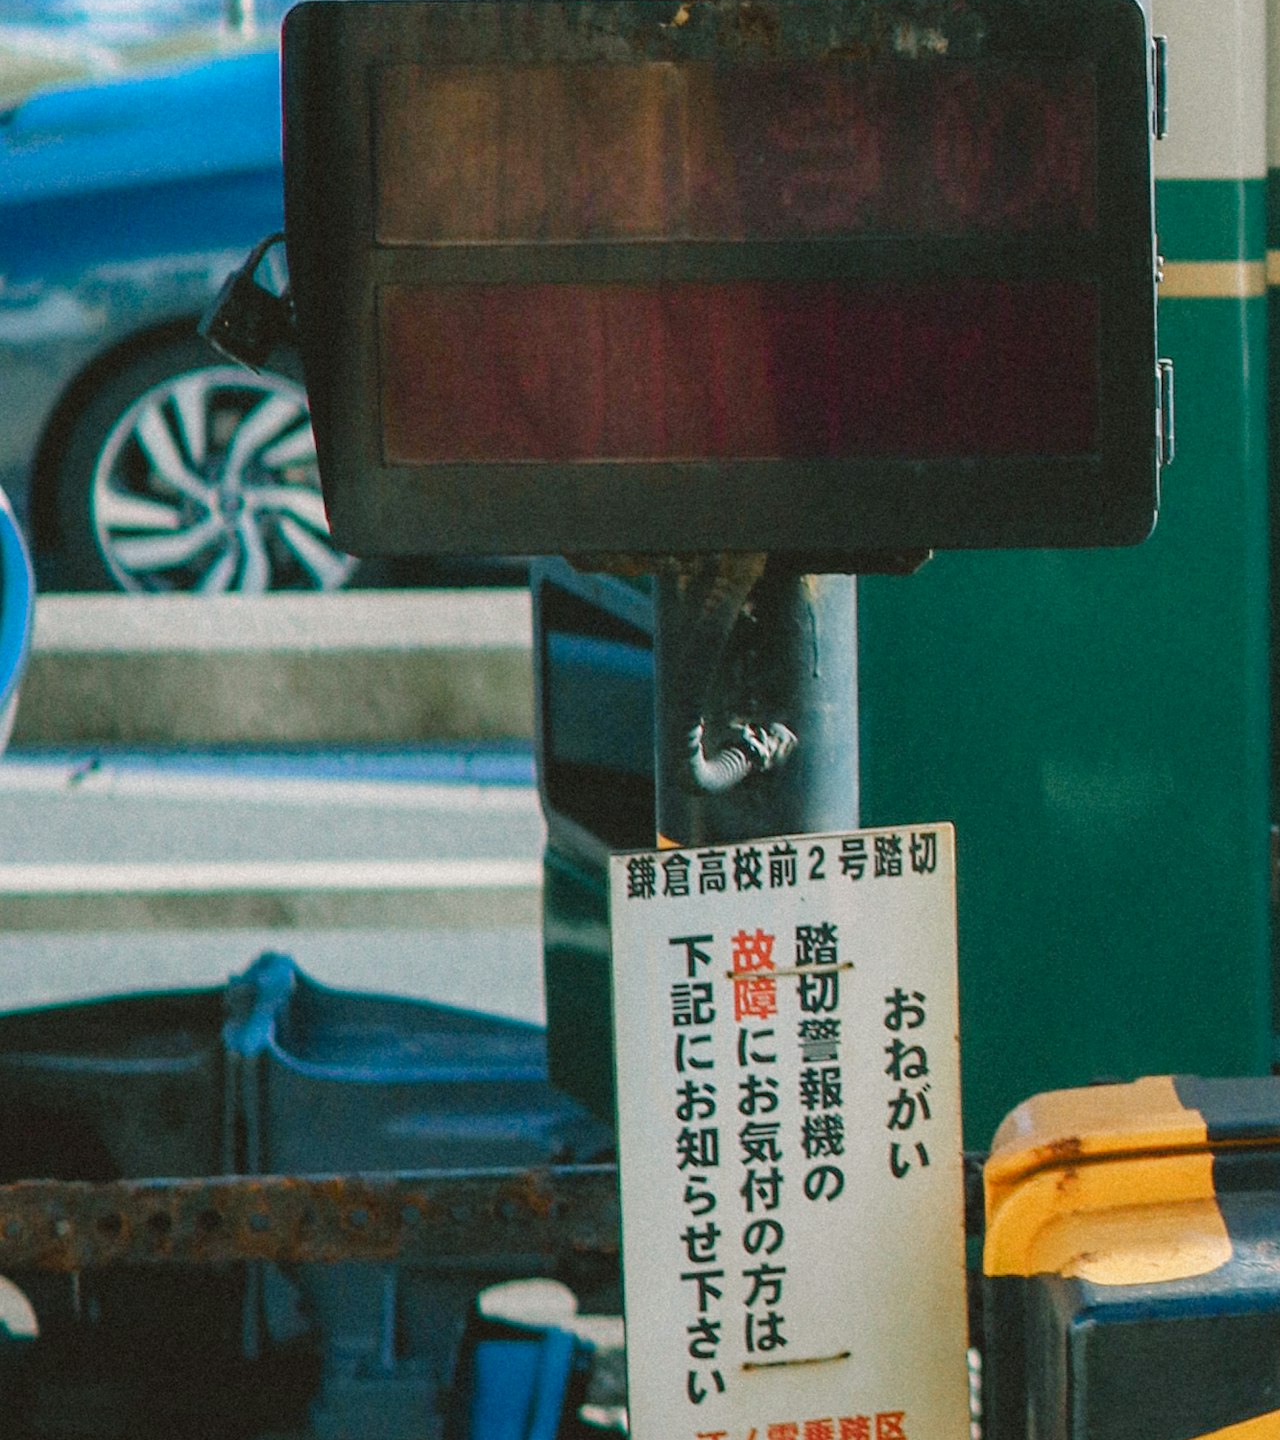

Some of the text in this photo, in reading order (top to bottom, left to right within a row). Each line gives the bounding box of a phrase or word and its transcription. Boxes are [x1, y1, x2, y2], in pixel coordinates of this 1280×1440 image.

[627, 831, 937, 900] 鎌倉高校前2号踏切
[668, 934, 726, 1406] 下記にお知らせ下さい
[730, 928, 788, 1353] 故障にお気付の方は
[795, 921, 845, 1203] 踏切警報機の
[884, 986, 932, 1180] おねがい
